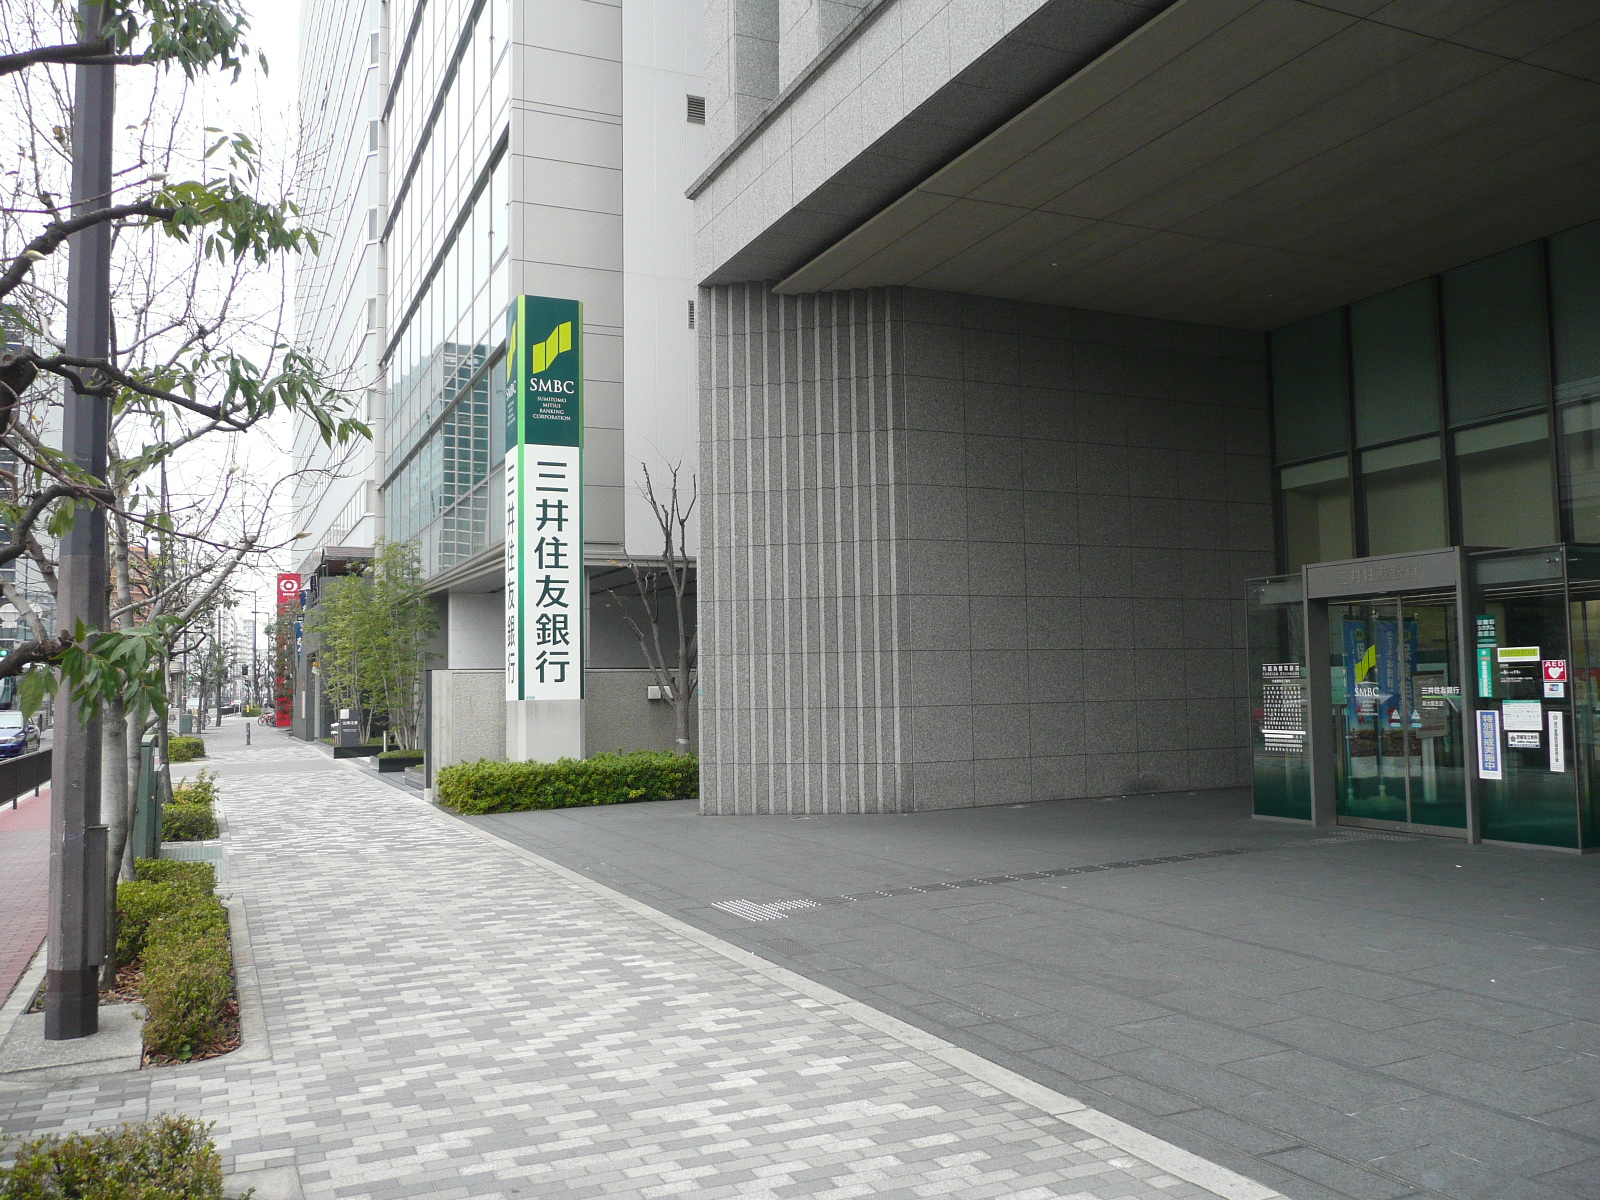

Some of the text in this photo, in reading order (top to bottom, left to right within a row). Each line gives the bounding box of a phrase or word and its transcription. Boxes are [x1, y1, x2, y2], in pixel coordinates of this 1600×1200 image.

[529, 377, 575, 394] SMBC
[532, 413, 571, 421] CORPORATION
[506, 463, 516, 685] 三井住友銀行
[533, 460, 571, 684] 三井住友銀行
[1337, 562, 1419, 586] 三井住友銀行
[1354, 687, 1380, 697] SMBC
[1421, 686, 1460, 695] 三井住友銀行
